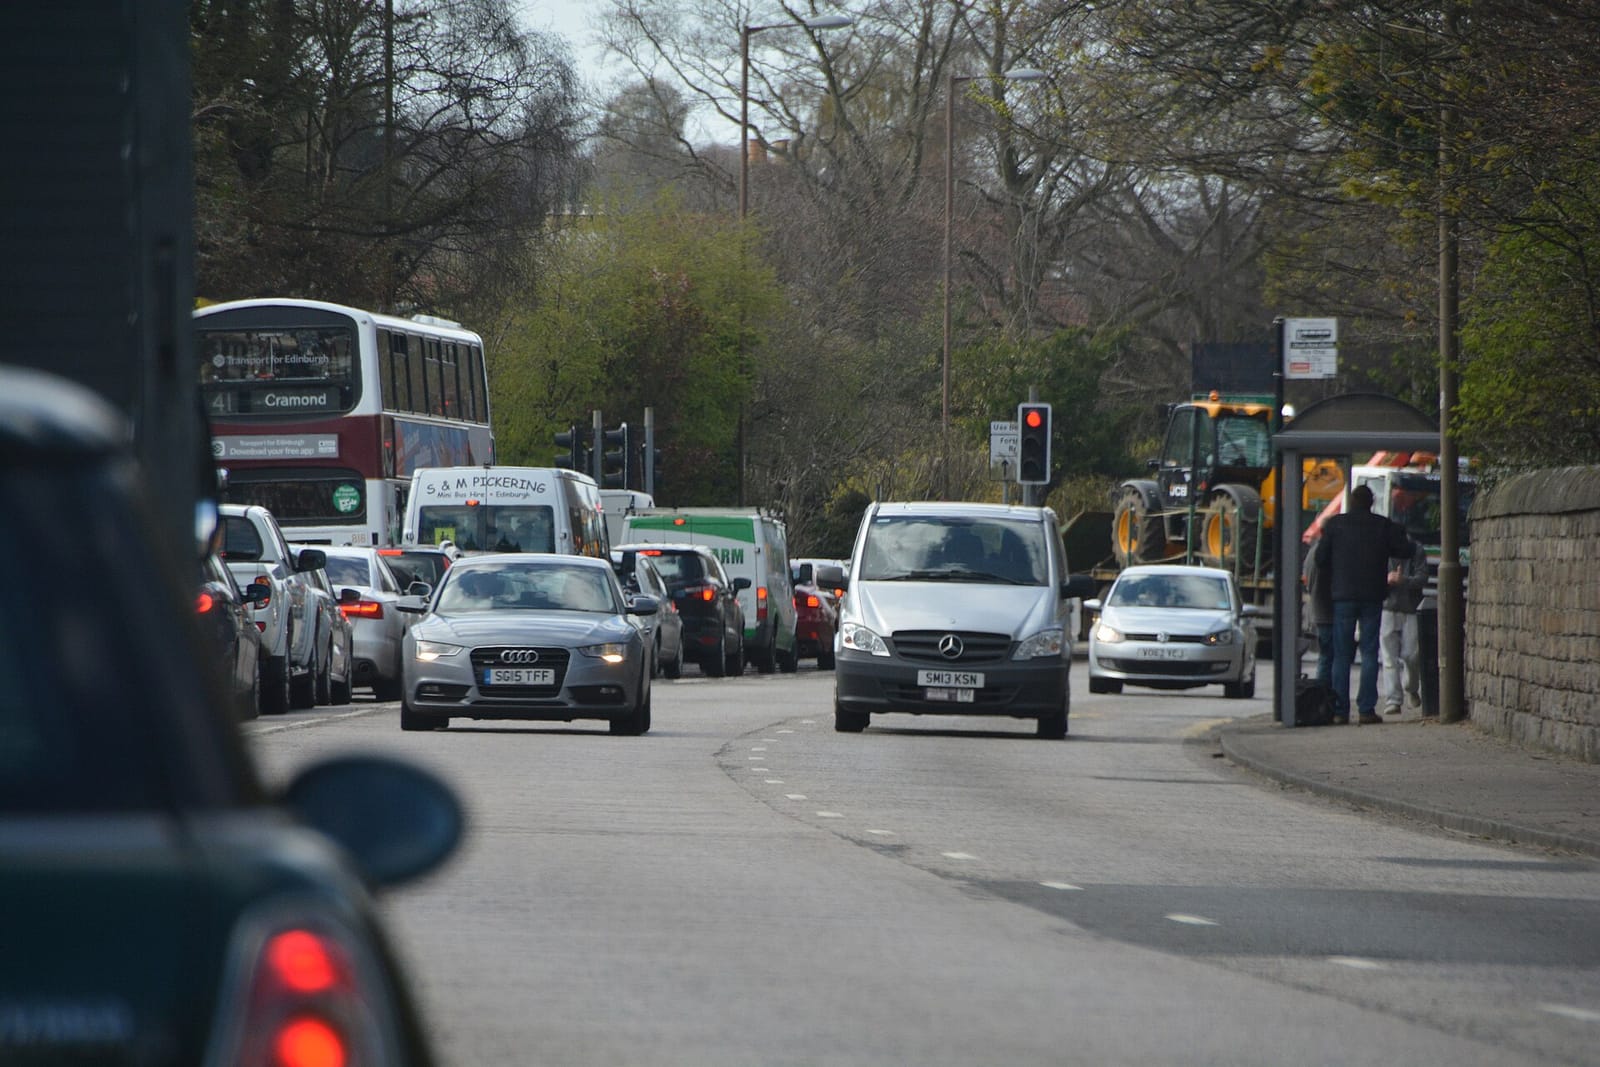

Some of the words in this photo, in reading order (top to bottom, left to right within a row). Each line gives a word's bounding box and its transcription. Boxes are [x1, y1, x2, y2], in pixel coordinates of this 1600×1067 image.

[227, 355, 269, 368] Transport
[272, 354, 283, 364] for
[285, 354, 329, 368] Edinburgh
[211, 391, 232, 412] 41
[264, 393, 327, 407] Cramond
[426, 484, 436, 495] S
[441, 480, 450, 491] &
[456, 478, 467, 489] M
[472, 477, 546, 494] PICKERING
[1169, 484, 1188, 497] JCB
[495, 491, 531, 500] Edinburgh
[495, 670, 522, 682] SG15
[526, 670, 549, 682] TFF
[925, 672, 951, 684] SM13
[954, 673, 977, 685] KSN
